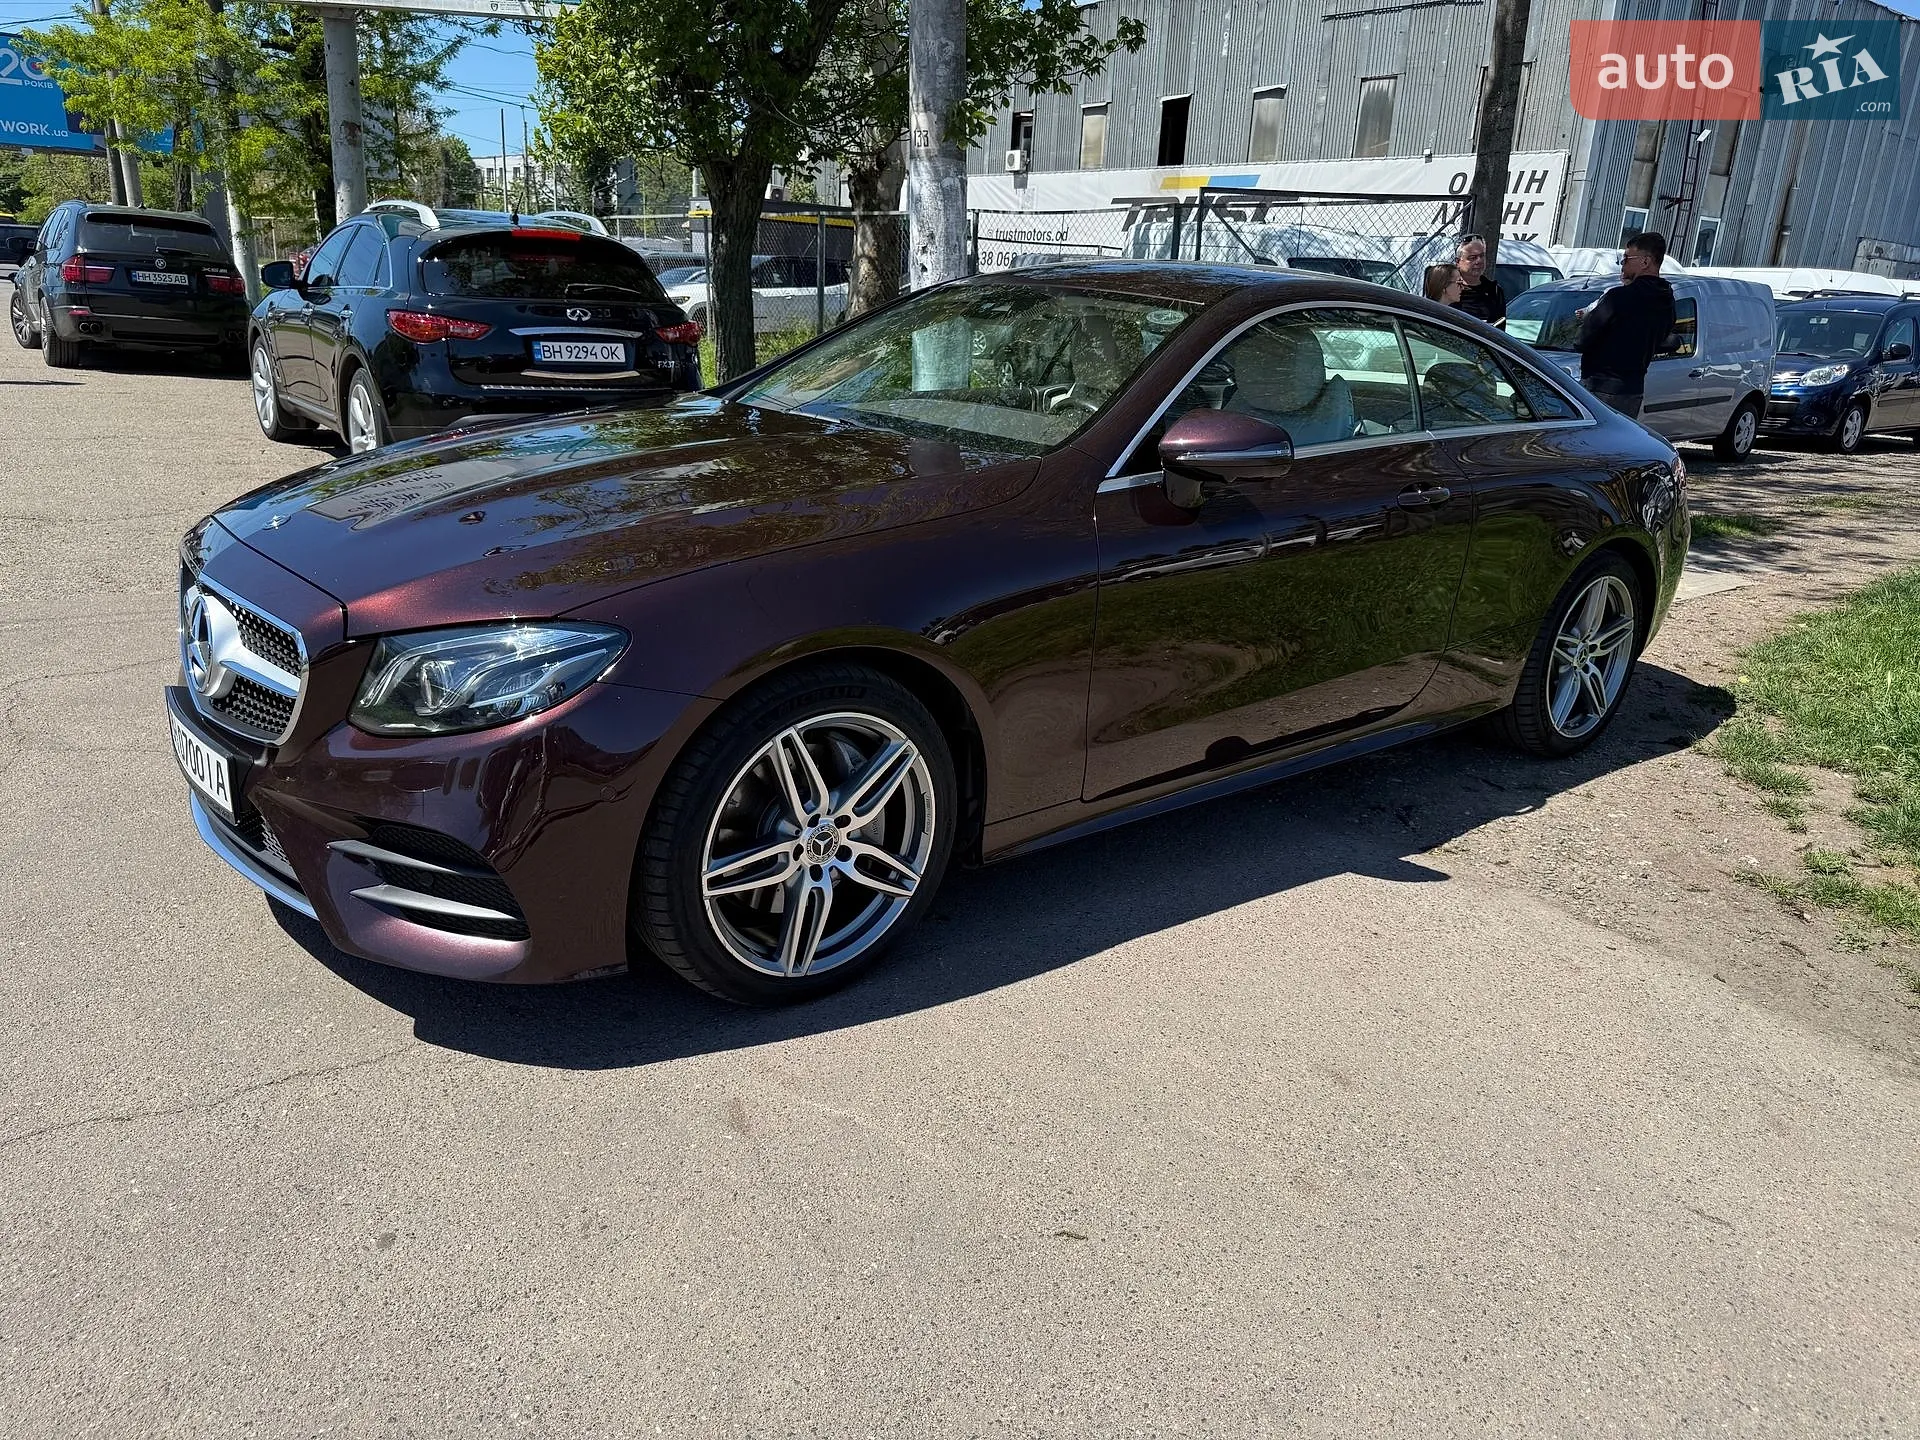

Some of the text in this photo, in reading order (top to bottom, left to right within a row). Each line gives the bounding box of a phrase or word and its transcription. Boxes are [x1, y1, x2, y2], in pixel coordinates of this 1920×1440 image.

[24, 80, 54, 89] РОКІВ
[995, 227, 1069, 241] trustmotors.od
[152, 273, 173, 283] 3525
[542, 345, 621, 361] BH 9294 OK
